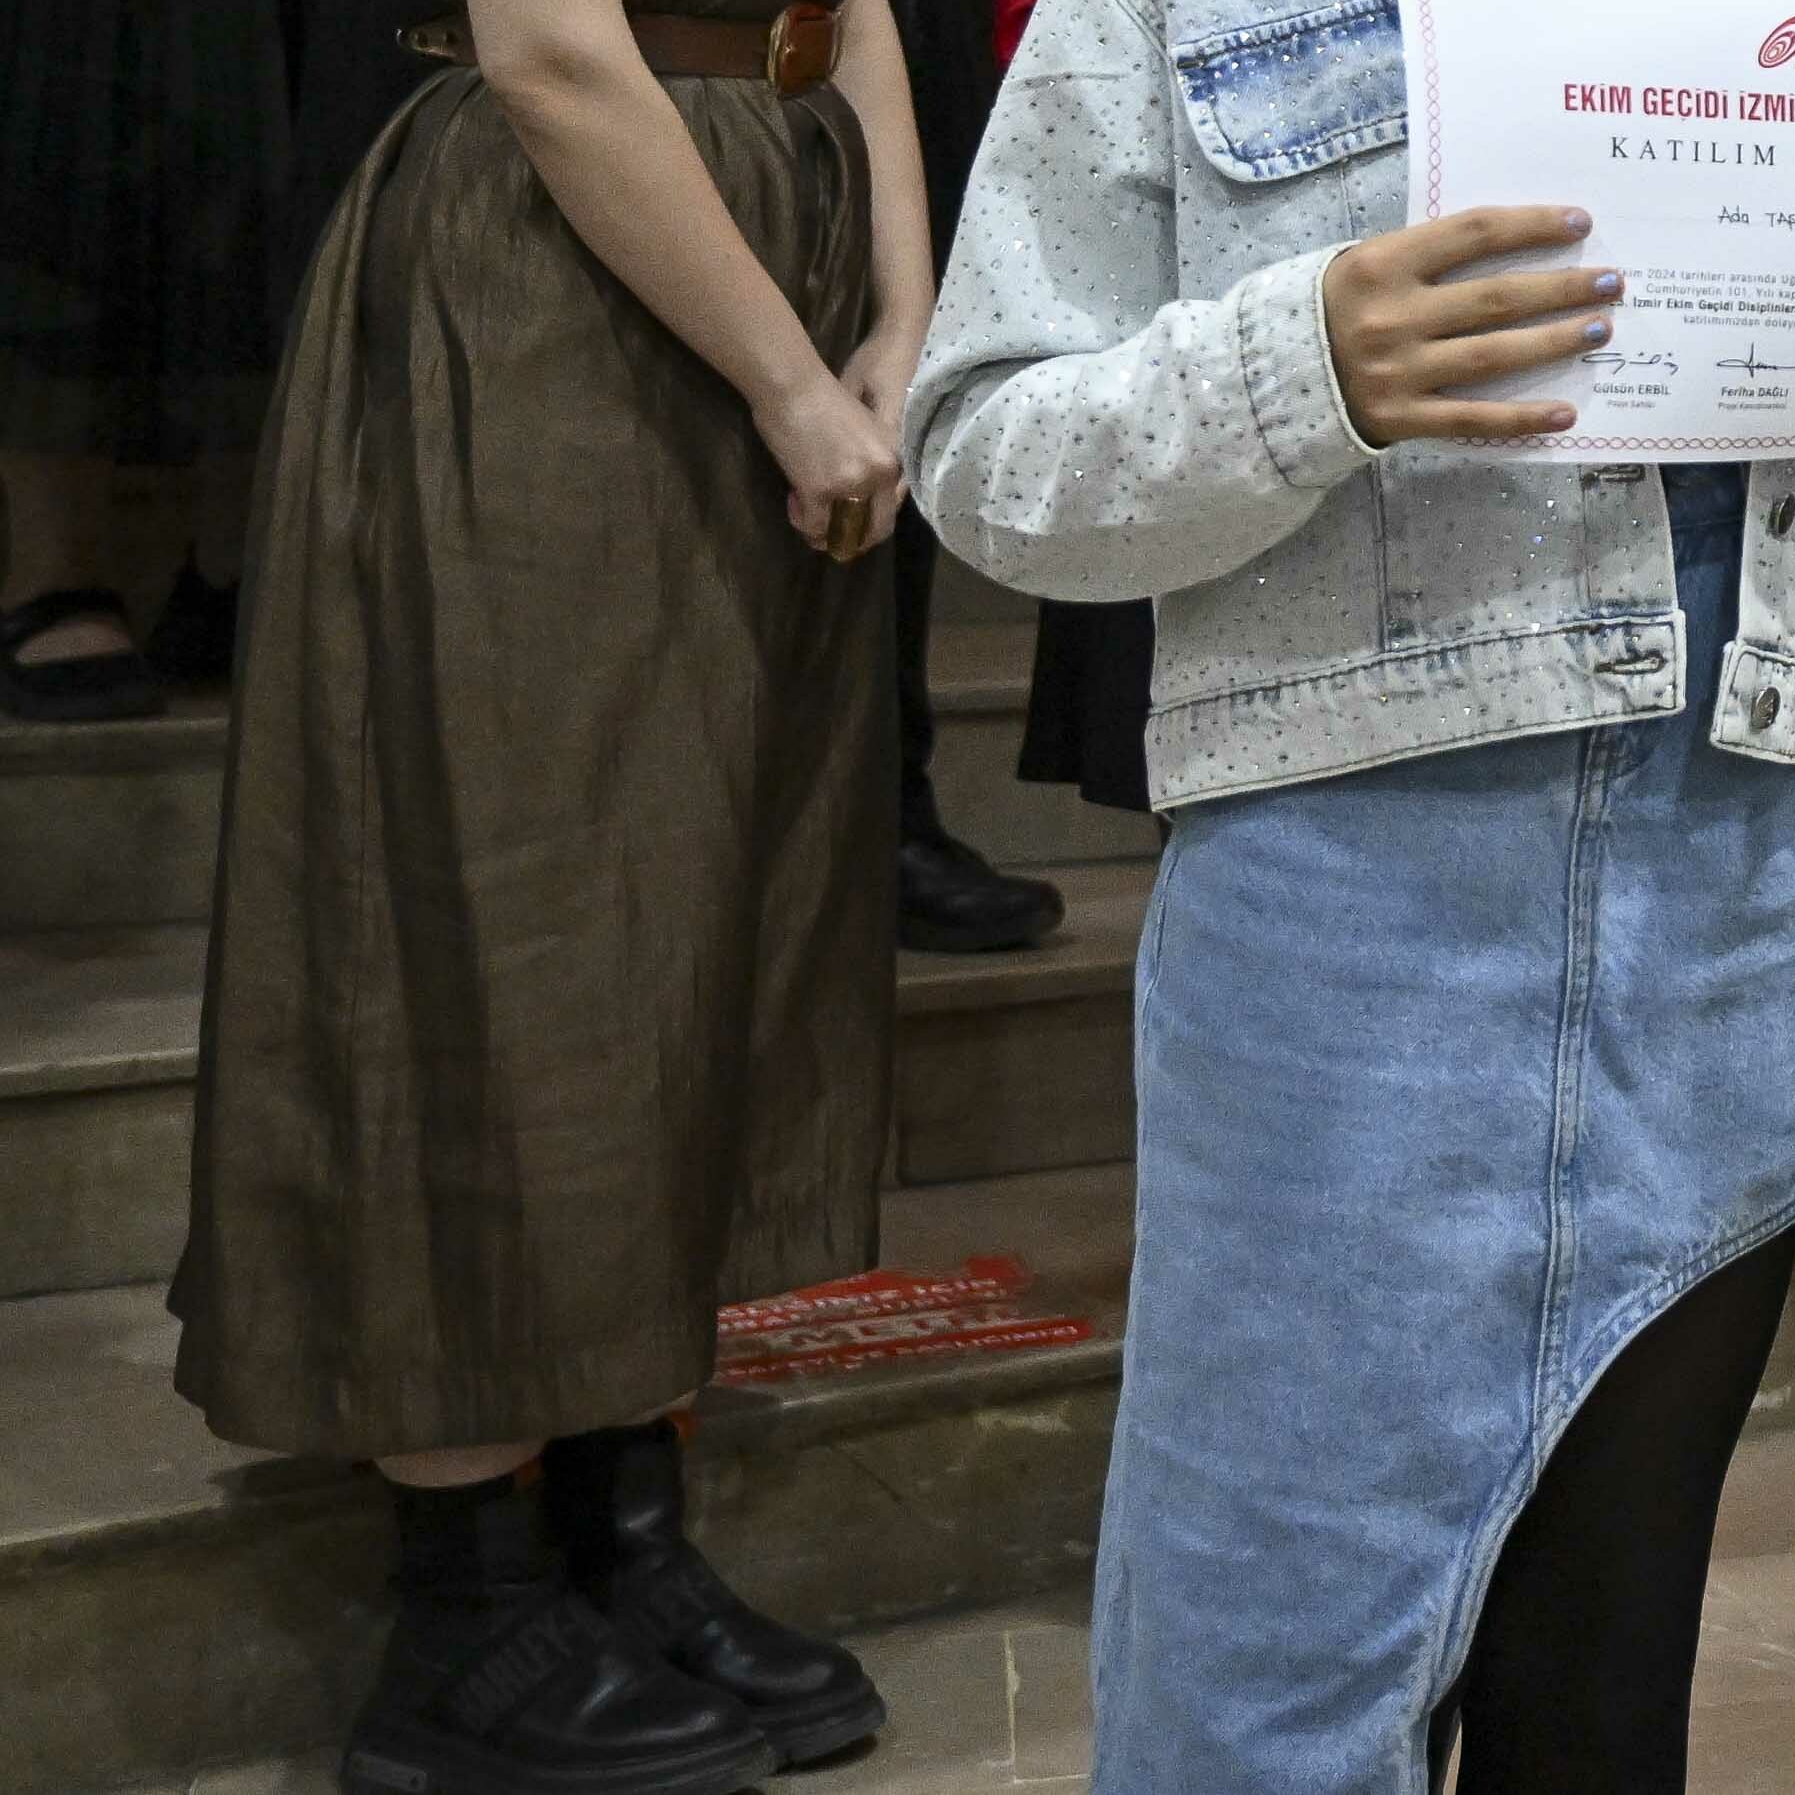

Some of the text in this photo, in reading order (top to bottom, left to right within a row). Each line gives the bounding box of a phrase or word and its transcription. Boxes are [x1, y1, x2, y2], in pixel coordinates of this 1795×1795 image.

[1564, 83, 1632, 114] EKİM
[1643, 87, 1729, 121] GEÇİDİ
[1611, 136, 1775, 166] KATILIM
[1718, 205, 1750, 225] Ada
[1648, 268, 1676, 279] 2024
[1667, 298, 1694, 309] Ekim
